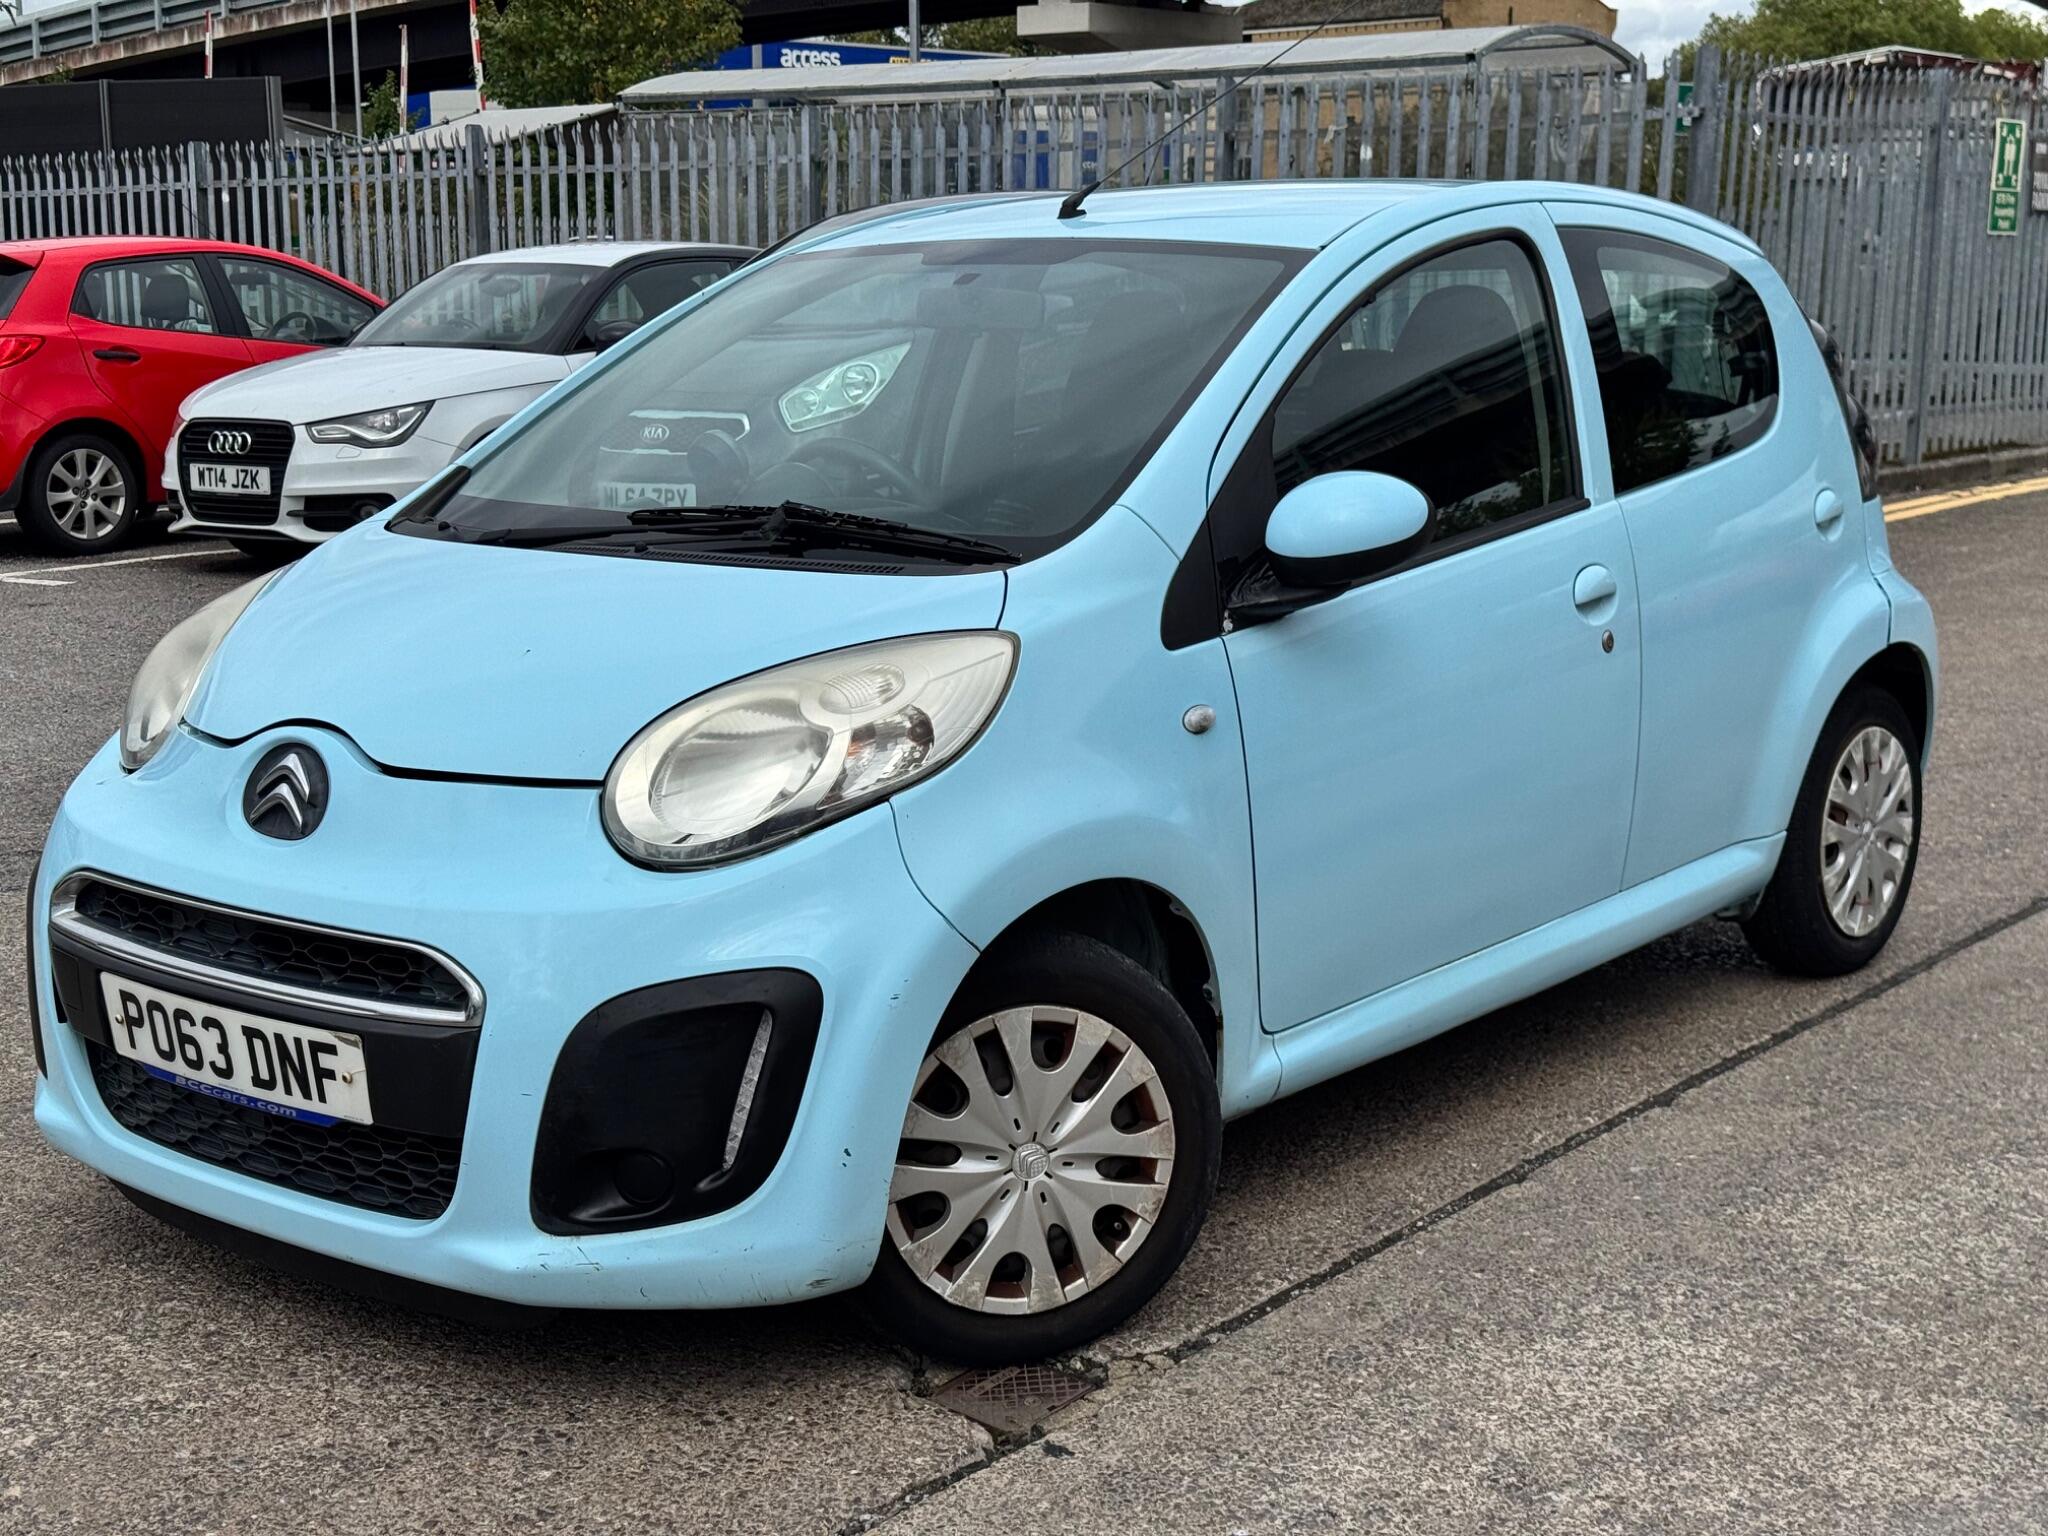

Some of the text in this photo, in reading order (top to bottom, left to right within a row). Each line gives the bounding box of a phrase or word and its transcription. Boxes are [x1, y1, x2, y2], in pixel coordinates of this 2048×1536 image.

[780, 48, 840, 68] access
[197, 466, 260, 490] WT14 JZK
[119, 989, 338, 1104] PO63 DNF
